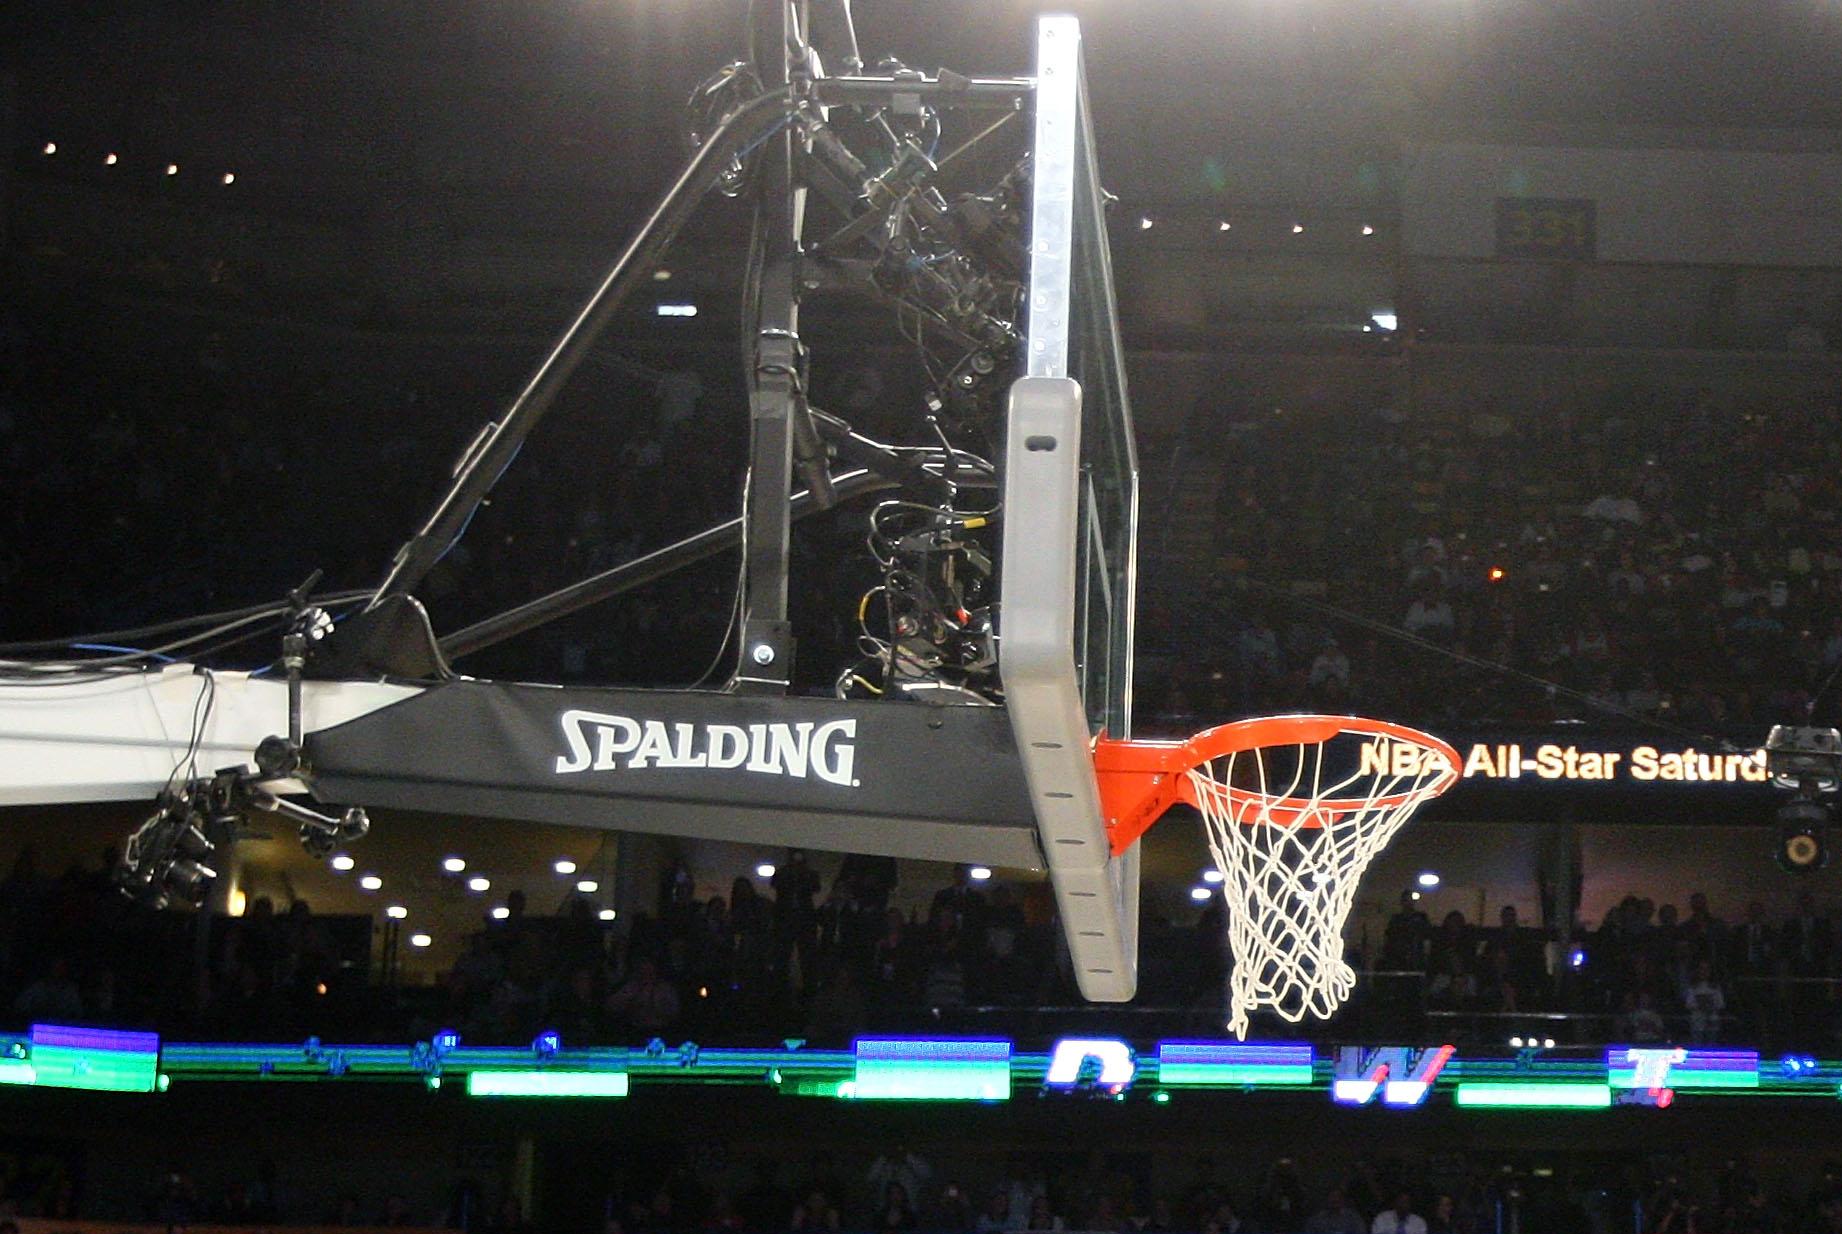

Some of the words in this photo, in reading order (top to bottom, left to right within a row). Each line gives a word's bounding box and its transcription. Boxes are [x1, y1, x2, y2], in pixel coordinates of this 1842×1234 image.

[556, 709, 858, 786] SPALDING
[1463, 743, 1620, 779] All-Star
[1630, 744, 1772, 782] Saturd
